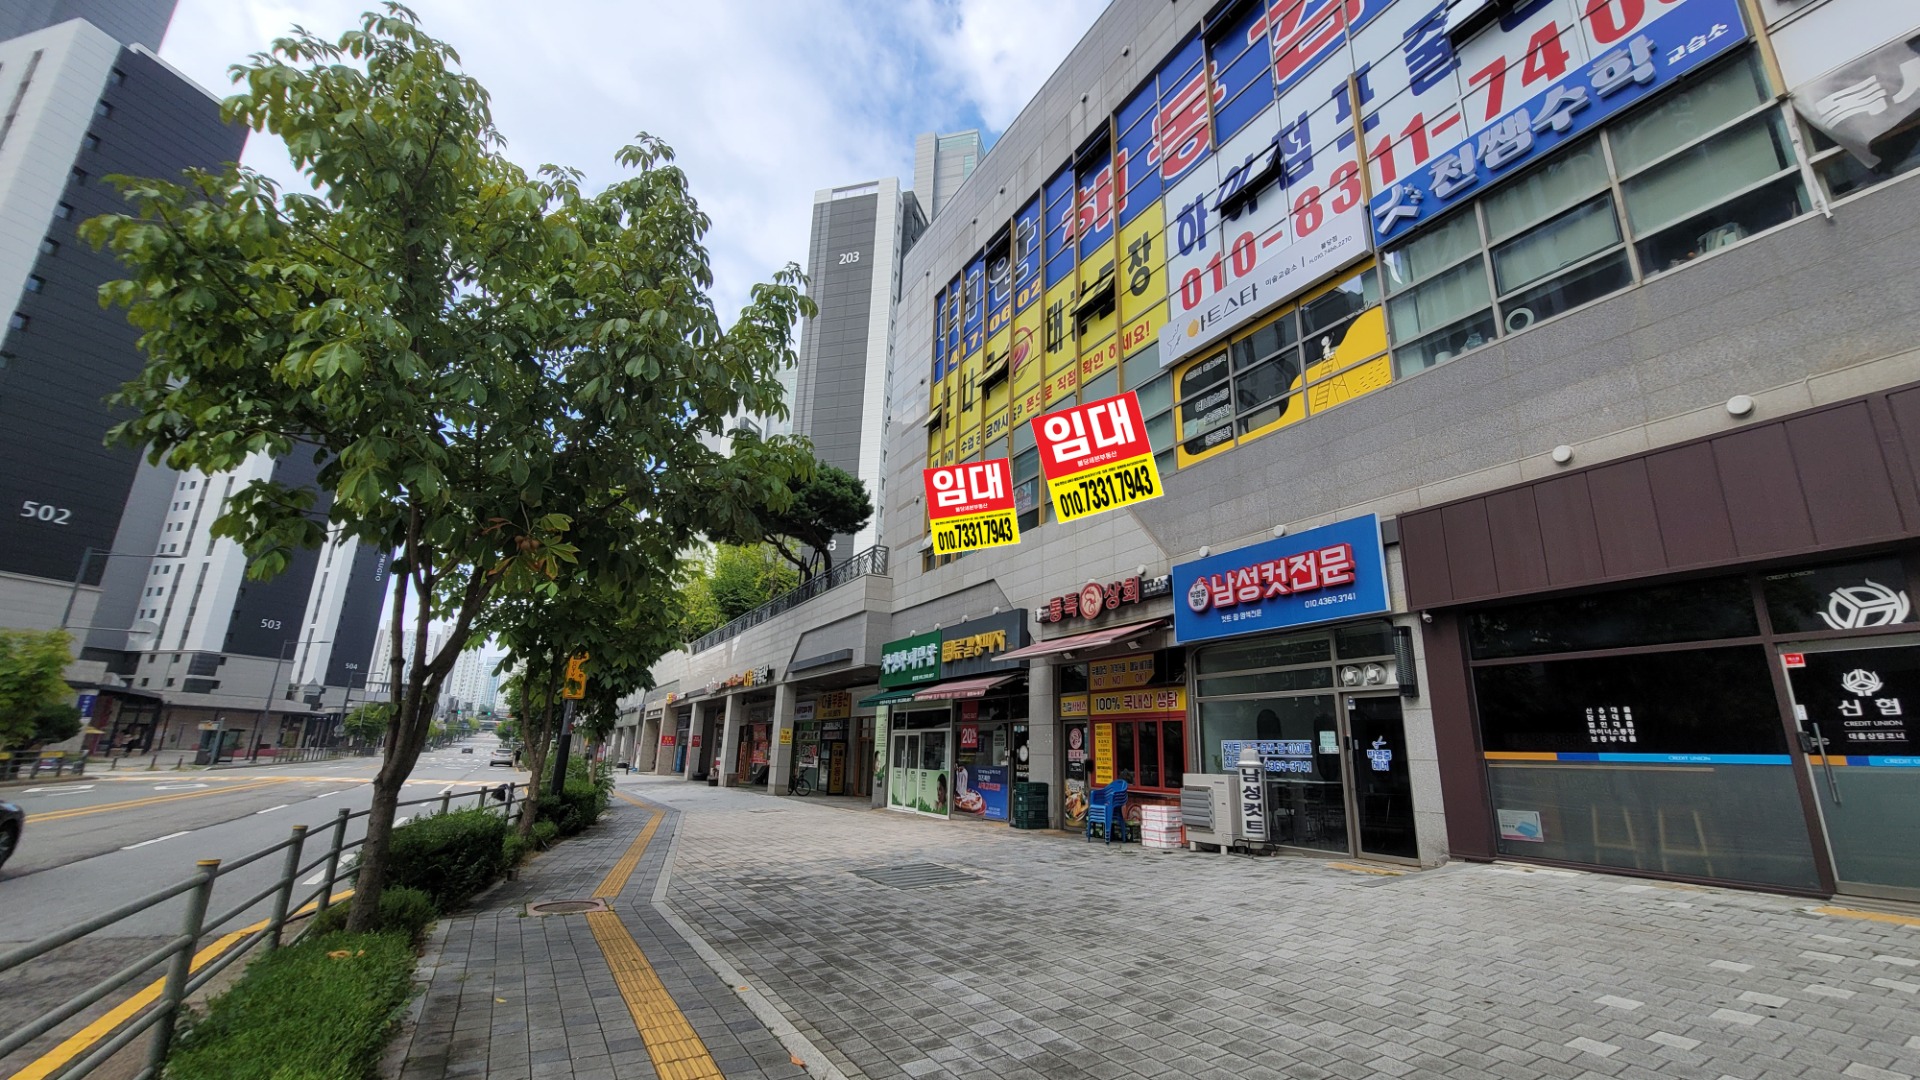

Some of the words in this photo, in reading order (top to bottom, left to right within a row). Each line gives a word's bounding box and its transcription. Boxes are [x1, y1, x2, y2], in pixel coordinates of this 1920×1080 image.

[1430, 34, 1657, 197] 천쌤수학
[1667, 23, 1729, 66] 교습소
[1180, 0, 1691, 311] 010-8311-740
[838, 251, 860, 265] 203
[1187, 283, 1258, 338] 아트스타
[1265, 263, 1297, 286] 미술교습소
[960, 434, 975, 454] 수업
[1026, 383, 1053, 413] 폰으로
[1056, 368, 1077, 393] 직접
[1082, 350, 1105, 375] 확인
[20, 499, 72, 526] 502
[1211, 545, 1353, 608] 남성컷전문
[1104, 576, 1141, 610] 상회
[1304, 593, 1357, 609] 010.4369.3741
[260, 618, 282, 630] 503
[344, 662, 358, 670] 504
[1096, 696, 1120, 711] 100%
[1123, 693, 1153, 710] 국내산
[1156, 690, 1178, 708] 생닭
[1586, 706, 1631, 714] 신용대출
[1837, 698, 1903, 717] 신협
[1586, 713, 1632, 721] 담보대출
[1589, 728, 1635, 736] 마이너스통장
[1848, 732, 1905, 740] 대출상담코너
[1241, 768, 1264, 834] 남성컷트
